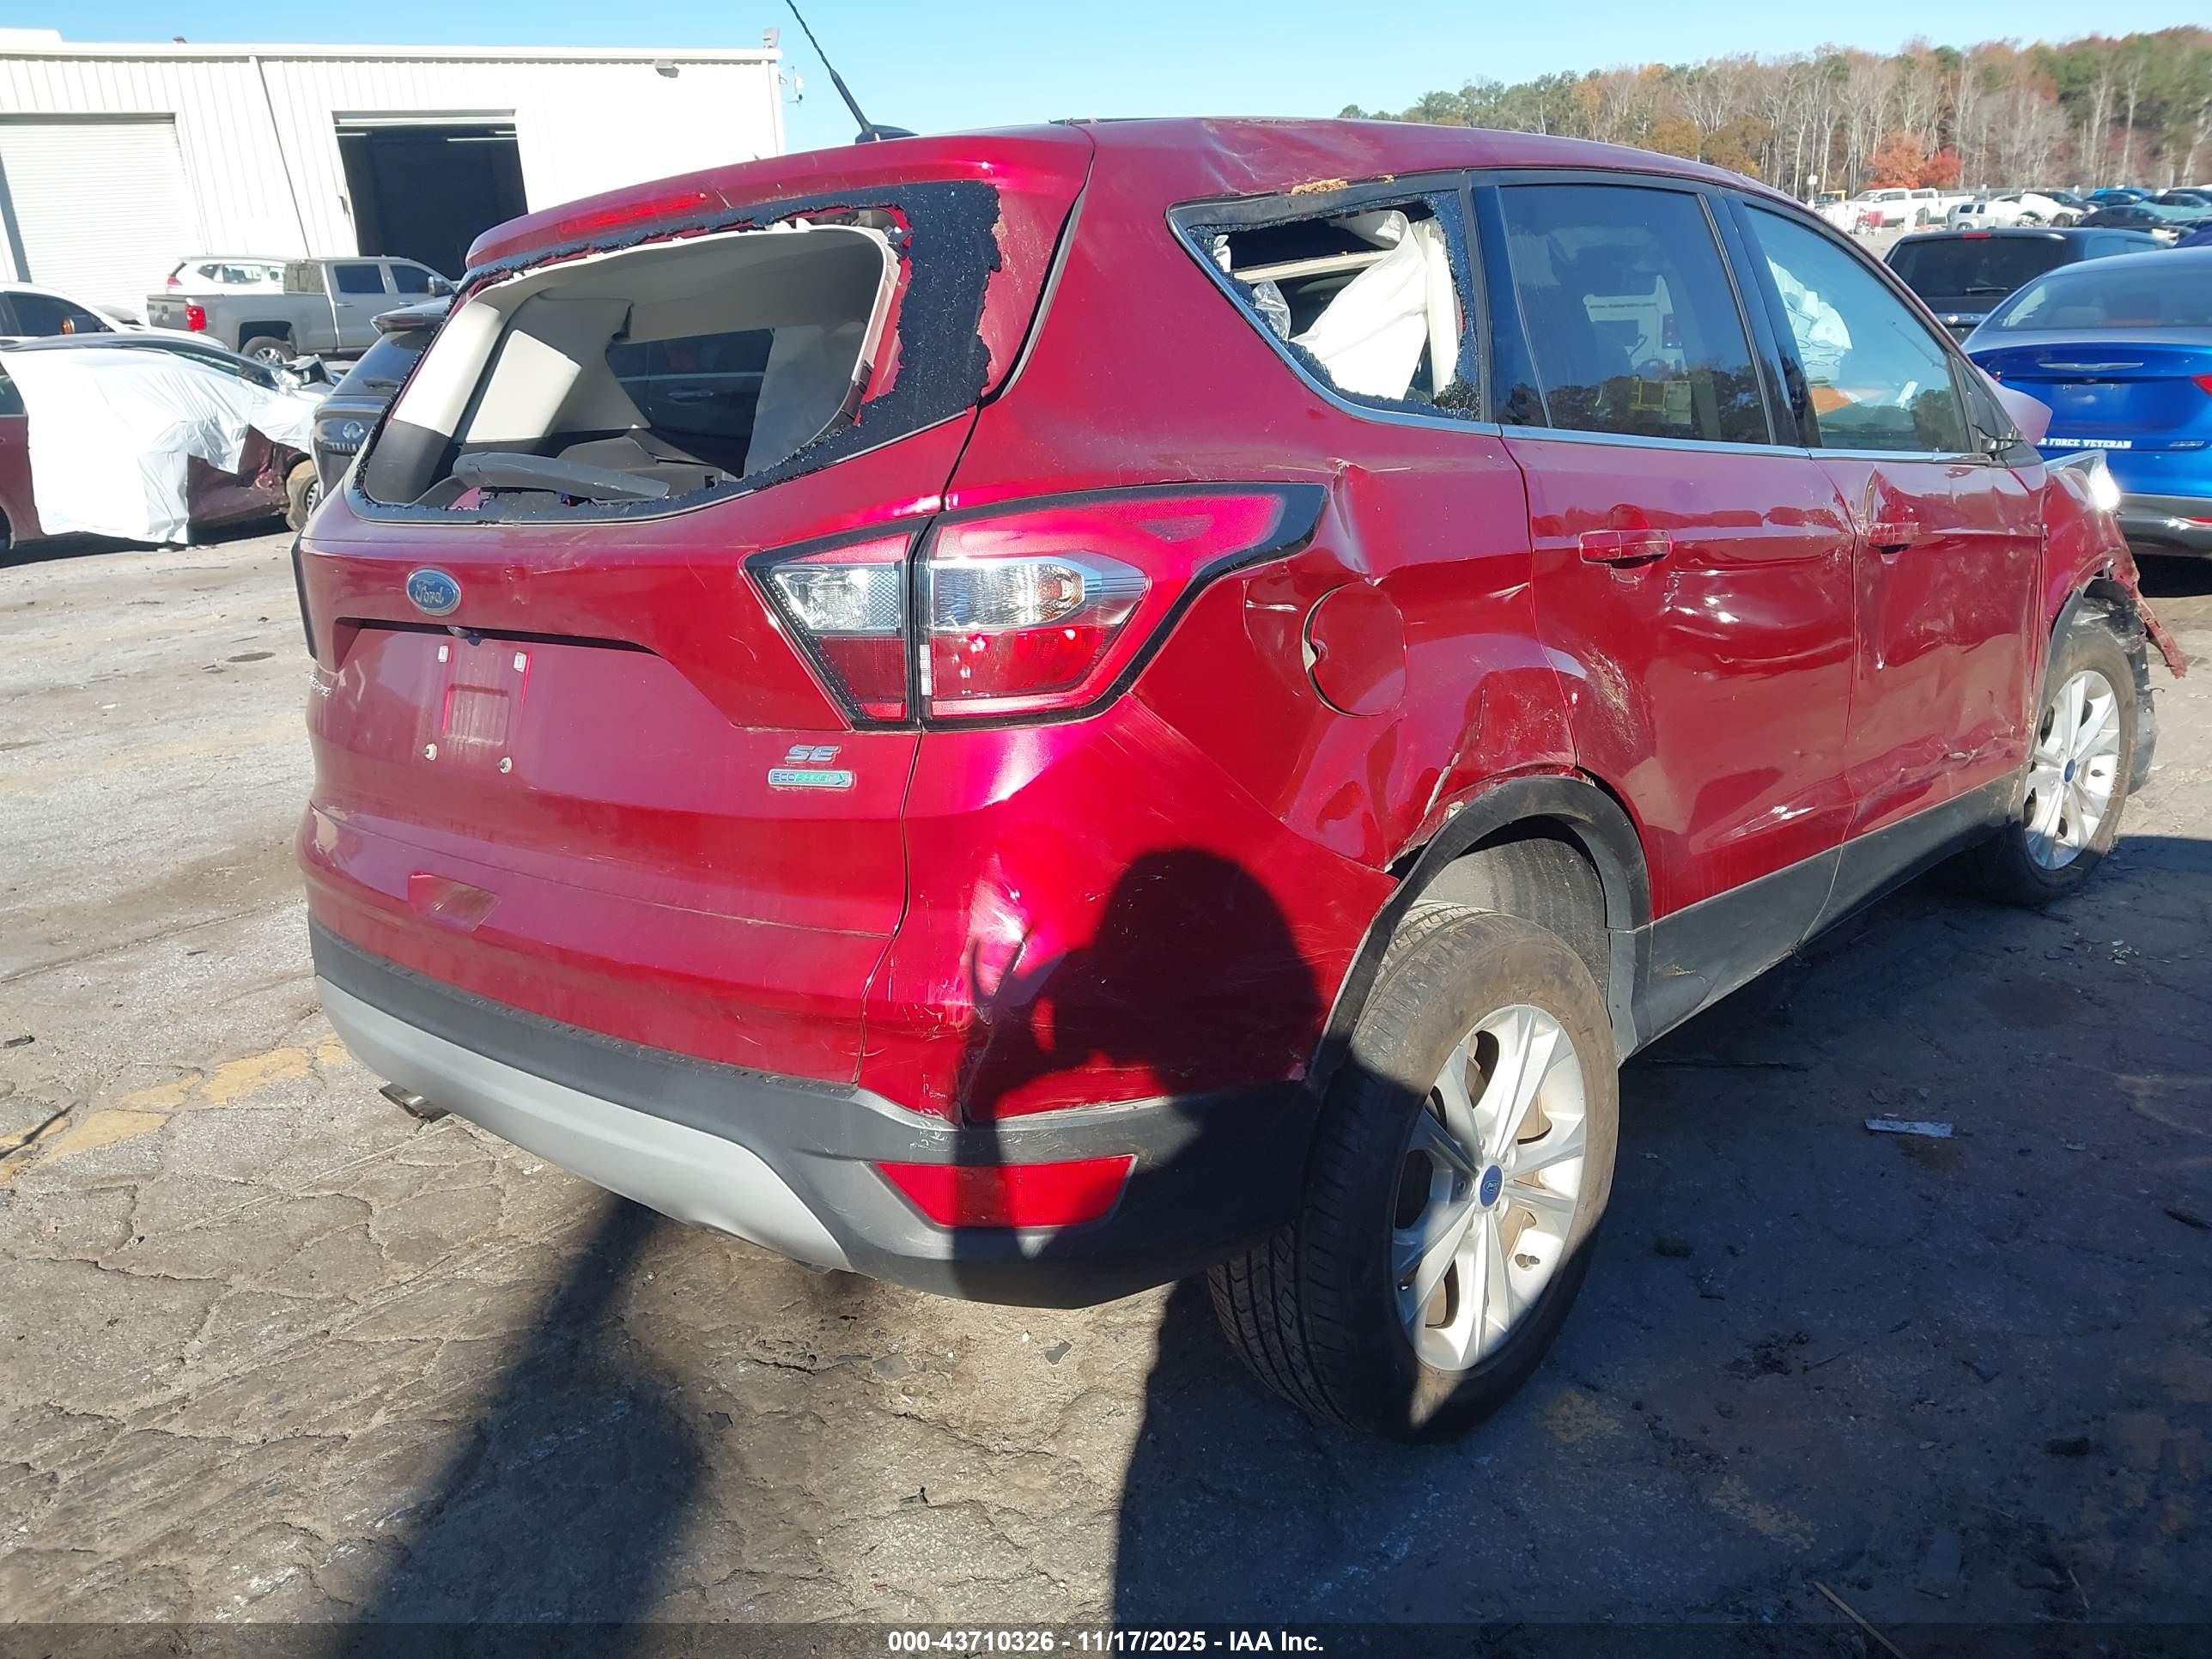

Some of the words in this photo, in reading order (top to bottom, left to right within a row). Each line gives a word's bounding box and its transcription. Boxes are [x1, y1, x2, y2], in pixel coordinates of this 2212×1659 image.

[2049, 438, 2081, 447] FORCE
[2082, 439, 2132, 449] VETERAN
[415, 579, 445, 605] Ford
[784, 744, 841, 763] SE
